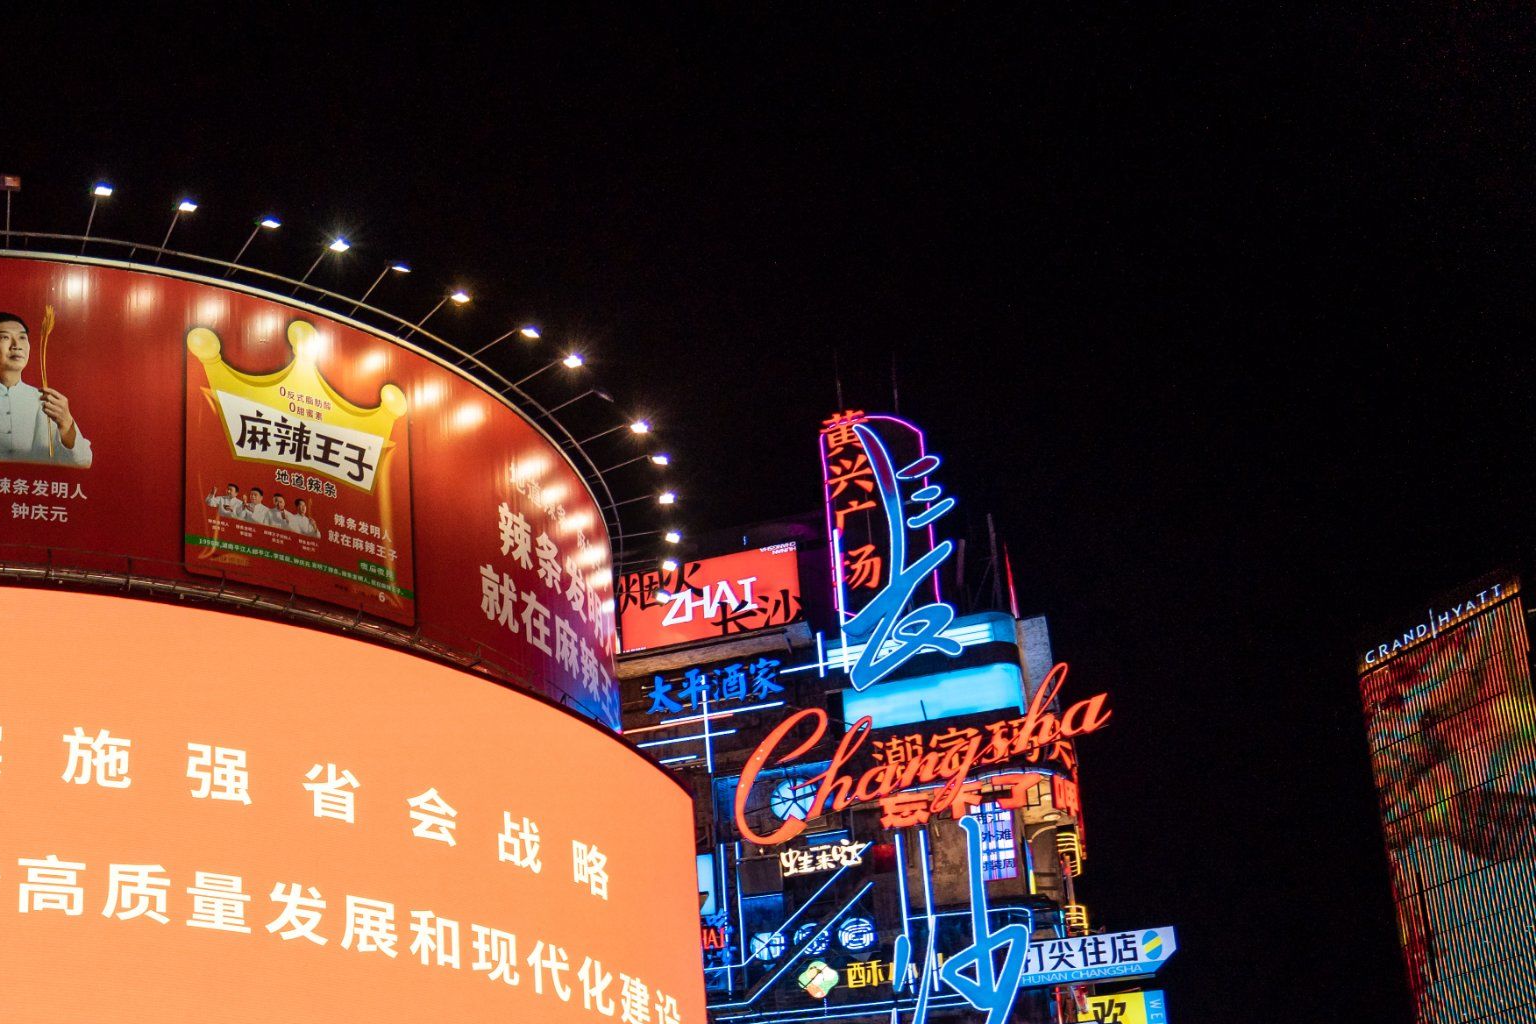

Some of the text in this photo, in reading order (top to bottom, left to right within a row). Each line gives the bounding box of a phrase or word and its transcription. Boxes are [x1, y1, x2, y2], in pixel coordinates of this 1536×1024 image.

[236, 410, 374, 482] 麻辣王子
[275, 469, 338, 499] 地道辣条
[11, 502, 68, 523] 钟庆元
[333, 513, 392, 542] 辣条发明人
[328, 530, 398, 562] 就在麻辣王子
[662, 576, 757, 627] ZHAI
[711, 589, 804, 636] 长沙
[1365, 583, 1501, 664] GRAND HYATT
[646, 657, 785, 715] 太平酒家
[735, 662, 1114, 841] Changsha
[1022, 963, 1143, 985] HUNAN CHANGSHA
